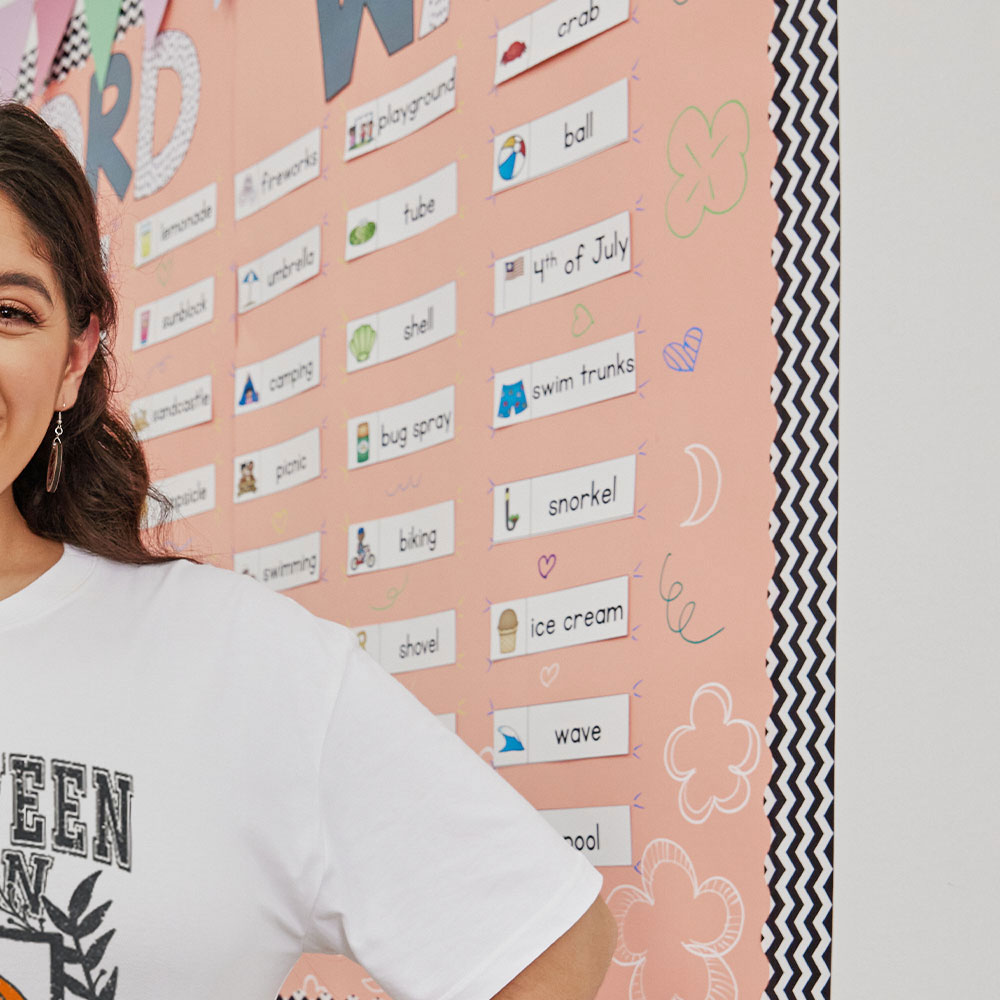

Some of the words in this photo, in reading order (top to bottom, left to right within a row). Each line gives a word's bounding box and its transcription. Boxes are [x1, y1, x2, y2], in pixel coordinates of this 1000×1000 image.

[557, 3, 600, 38] crab
[377, 66, 456, 131] playground
[563, 111, 594, 150] ball
[261, 149, 319, 196] fireworks
[403, 197, 435, 226] tube
[267, 247, 314, 288] umbrella
[534, 250, 559, 284] 4th
[564, 243, 585, 275] of
[592, 231, 629, 265] July
[403, 306, 434, 341] shell
[269, 361, 313, 392] camping
[532, 374, 574, 400] swim
[581, 353, 635, 386] trunks
[381, 418, 407, 448] bug
[412, 410, 452, 440] spray
[276, 454, 307, 486] picnic
[549, 475, 617, 517] snorkel
[399, 525, 437, 552] biking
[263, 554, 316, 583] swimming
[530, 617, 555, 638] ice
[563, 603, 623, 631] cream
[398, 627, 439, 661] shovel
[554, 724, 602, 745] wave
